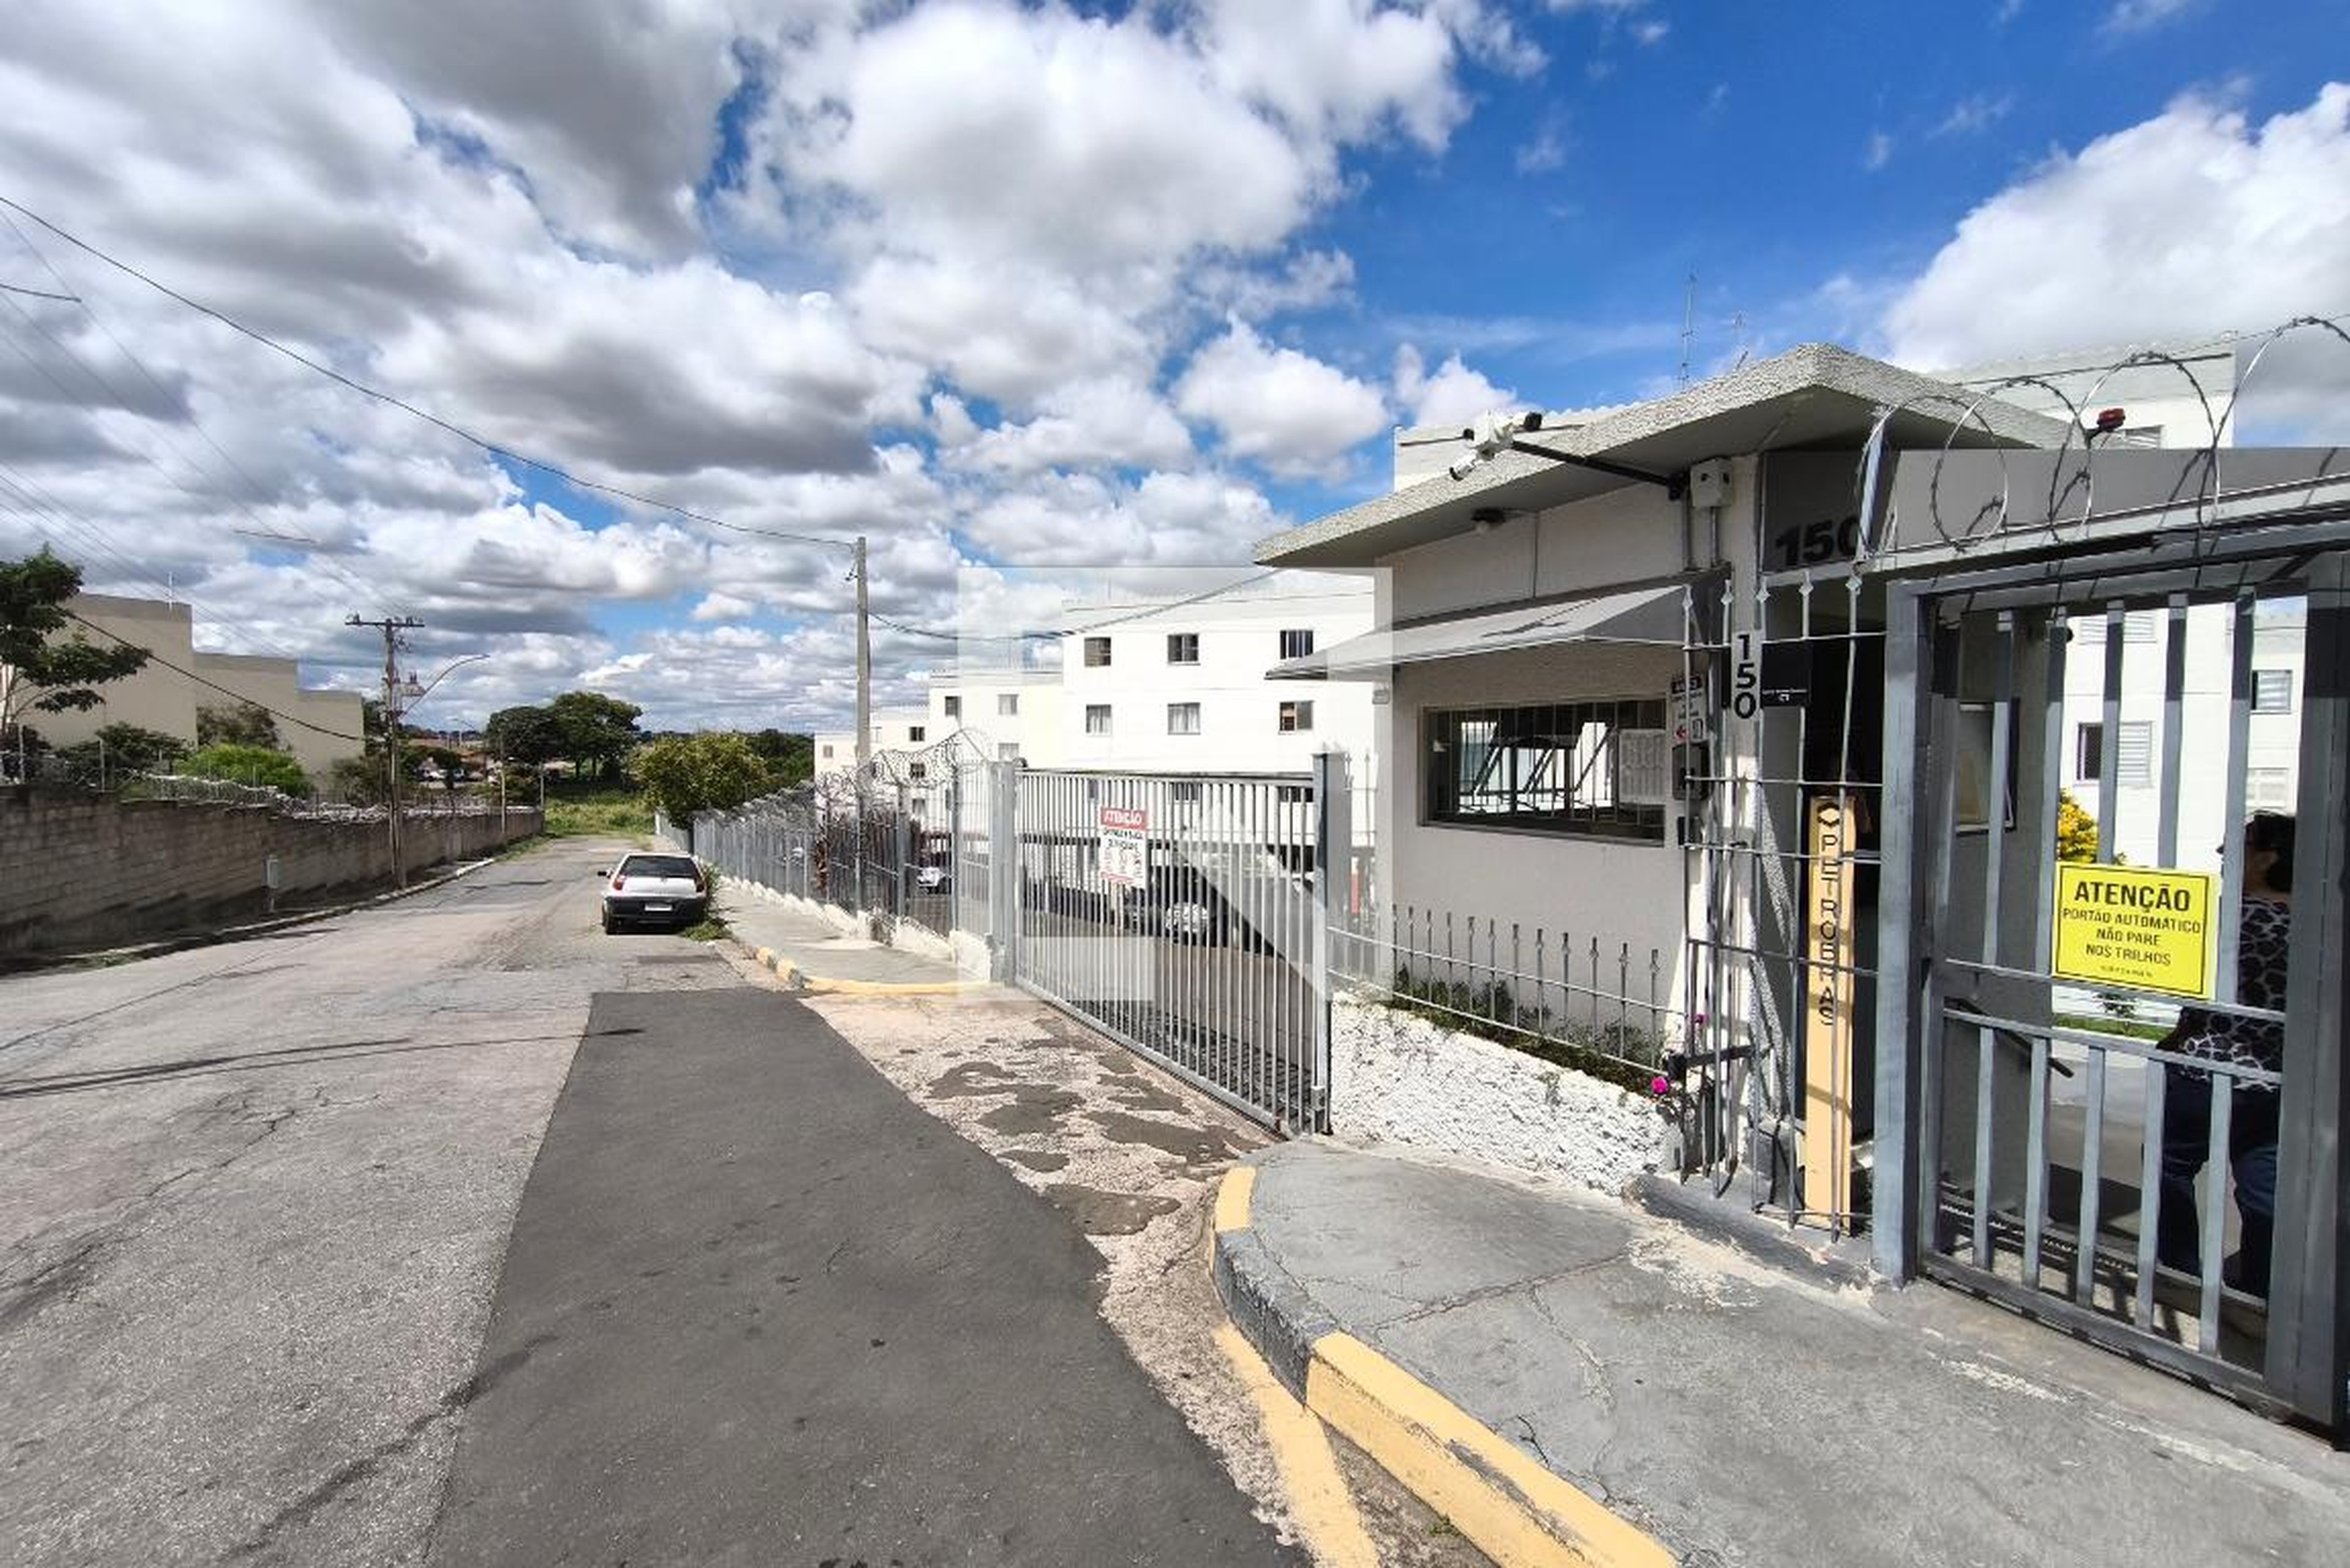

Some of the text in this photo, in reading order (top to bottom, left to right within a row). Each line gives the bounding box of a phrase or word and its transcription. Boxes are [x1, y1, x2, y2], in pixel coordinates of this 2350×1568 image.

[1775, 517, 1860, 566] 150
[1734, 634, 1756, 719] 150
[2075, 881, 2190, 913] ATENÇÃO
[2097, 927, 2161, 946] NÃO PARE
[2086, 944, 2171, 966] NOS TRILHOS
